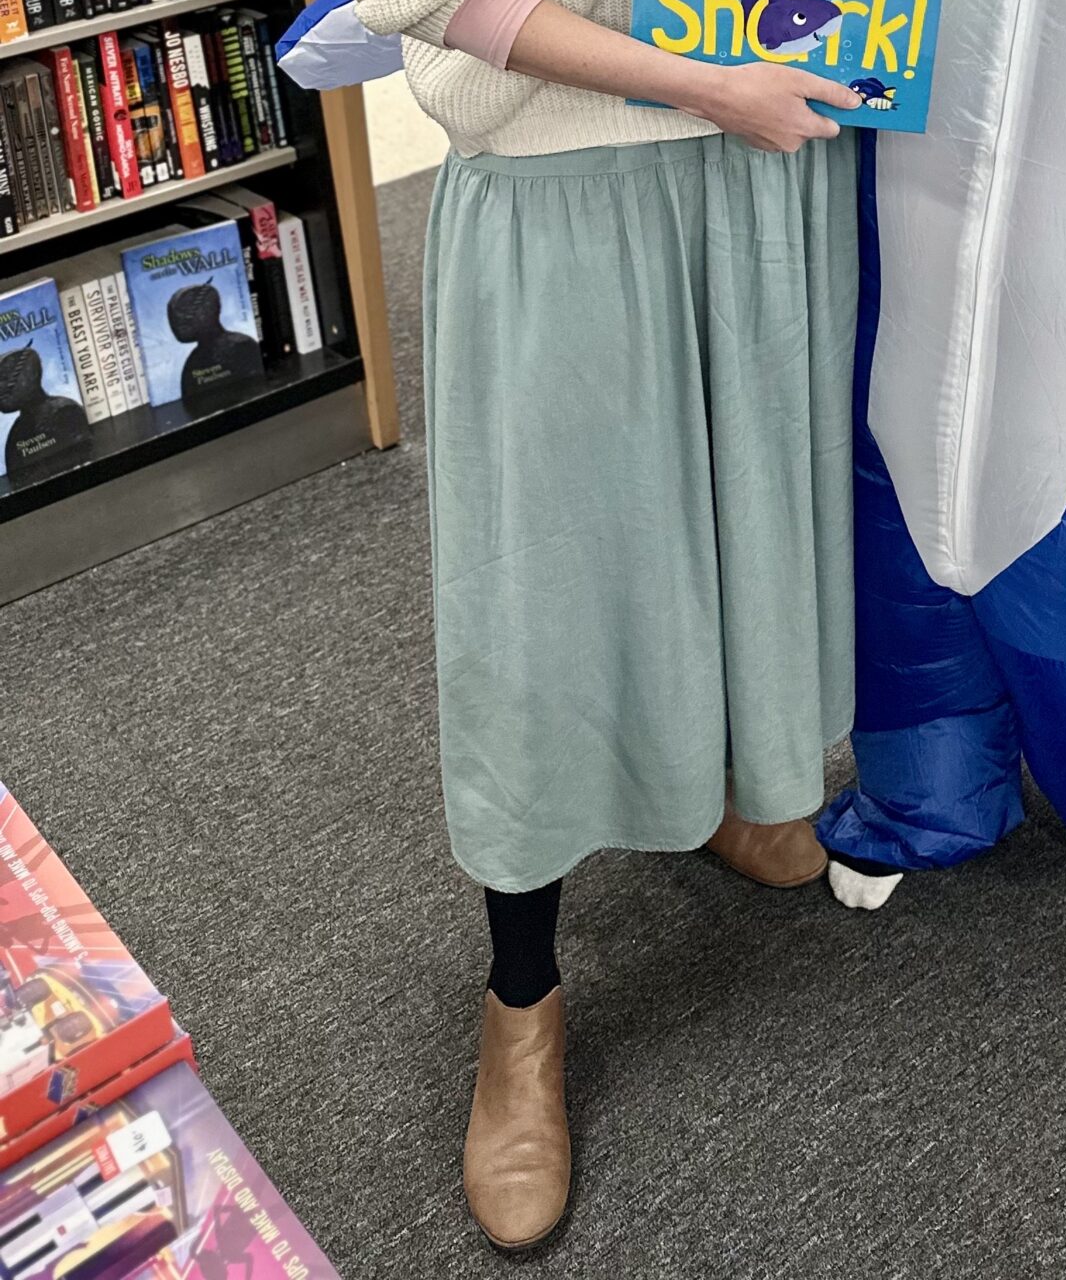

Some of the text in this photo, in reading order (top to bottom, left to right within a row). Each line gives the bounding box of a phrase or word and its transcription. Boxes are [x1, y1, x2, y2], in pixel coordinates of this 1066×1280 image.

[103, 36, 124, 107] SILVER NITRATE
[165, 31, 181, 47] JO
[85, 67, 104, 142] MEXICAN GOTHIC
[176, 248, 237, 277] WALL
[68, 308, 98, 396] BEAST YOU ARE
[86, 289, 121, 389] SURVIVOR SONG
[109, 294, 135, 384] PALLBEARERS CLUB
[8, 858, 84, 953] AMAZING POP-UPS TO MAKE
[206, 1147, 292, 1262] TO MAKE AND DISPLAY
